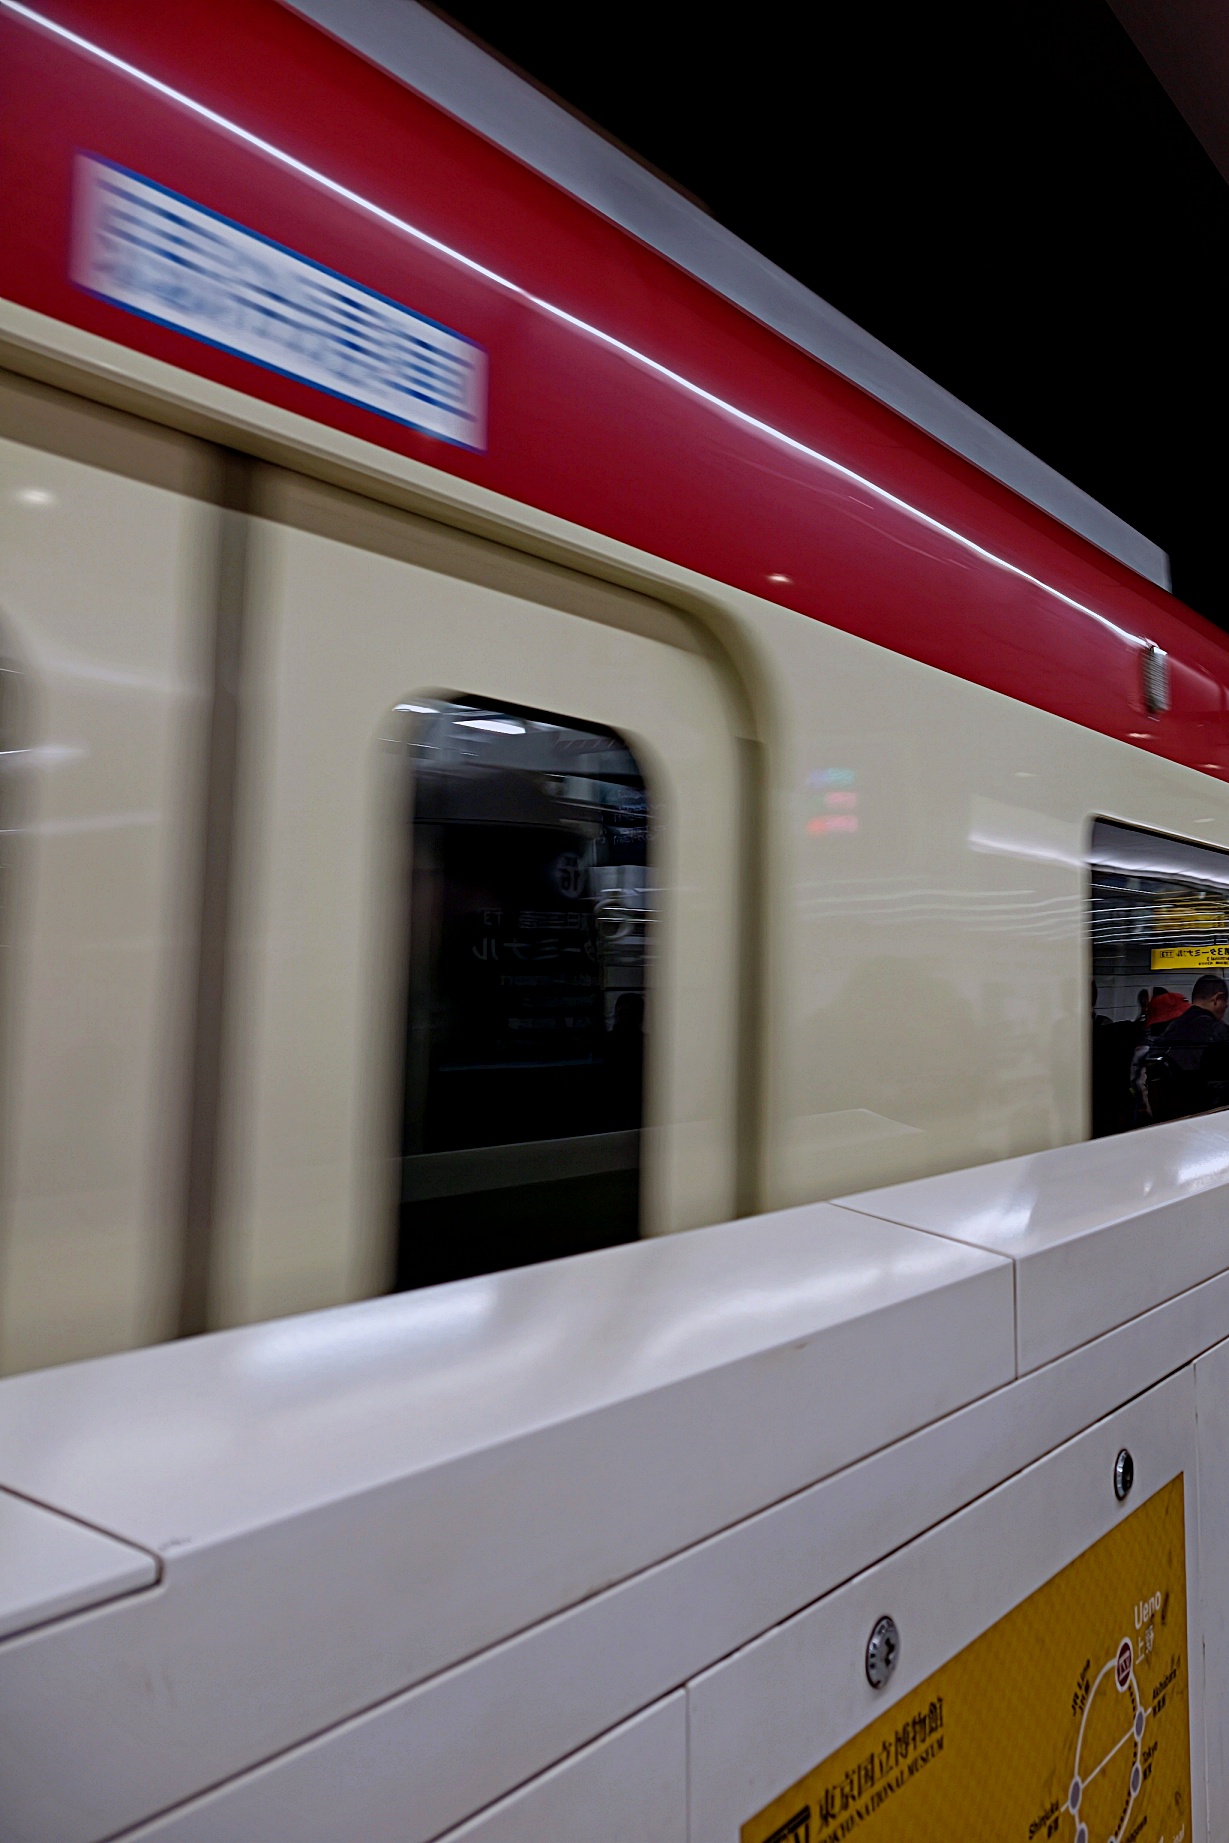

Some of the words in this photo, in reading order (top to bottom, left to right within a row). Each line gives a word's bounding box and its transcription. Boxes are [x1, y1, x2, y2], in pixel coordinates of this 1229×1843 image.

[1134, 1591, 1161, 1630] Ueno
[1135, 1625, 1154, 1665] 上野
[817, 1696, 944, 1836] 東京国立博物館
